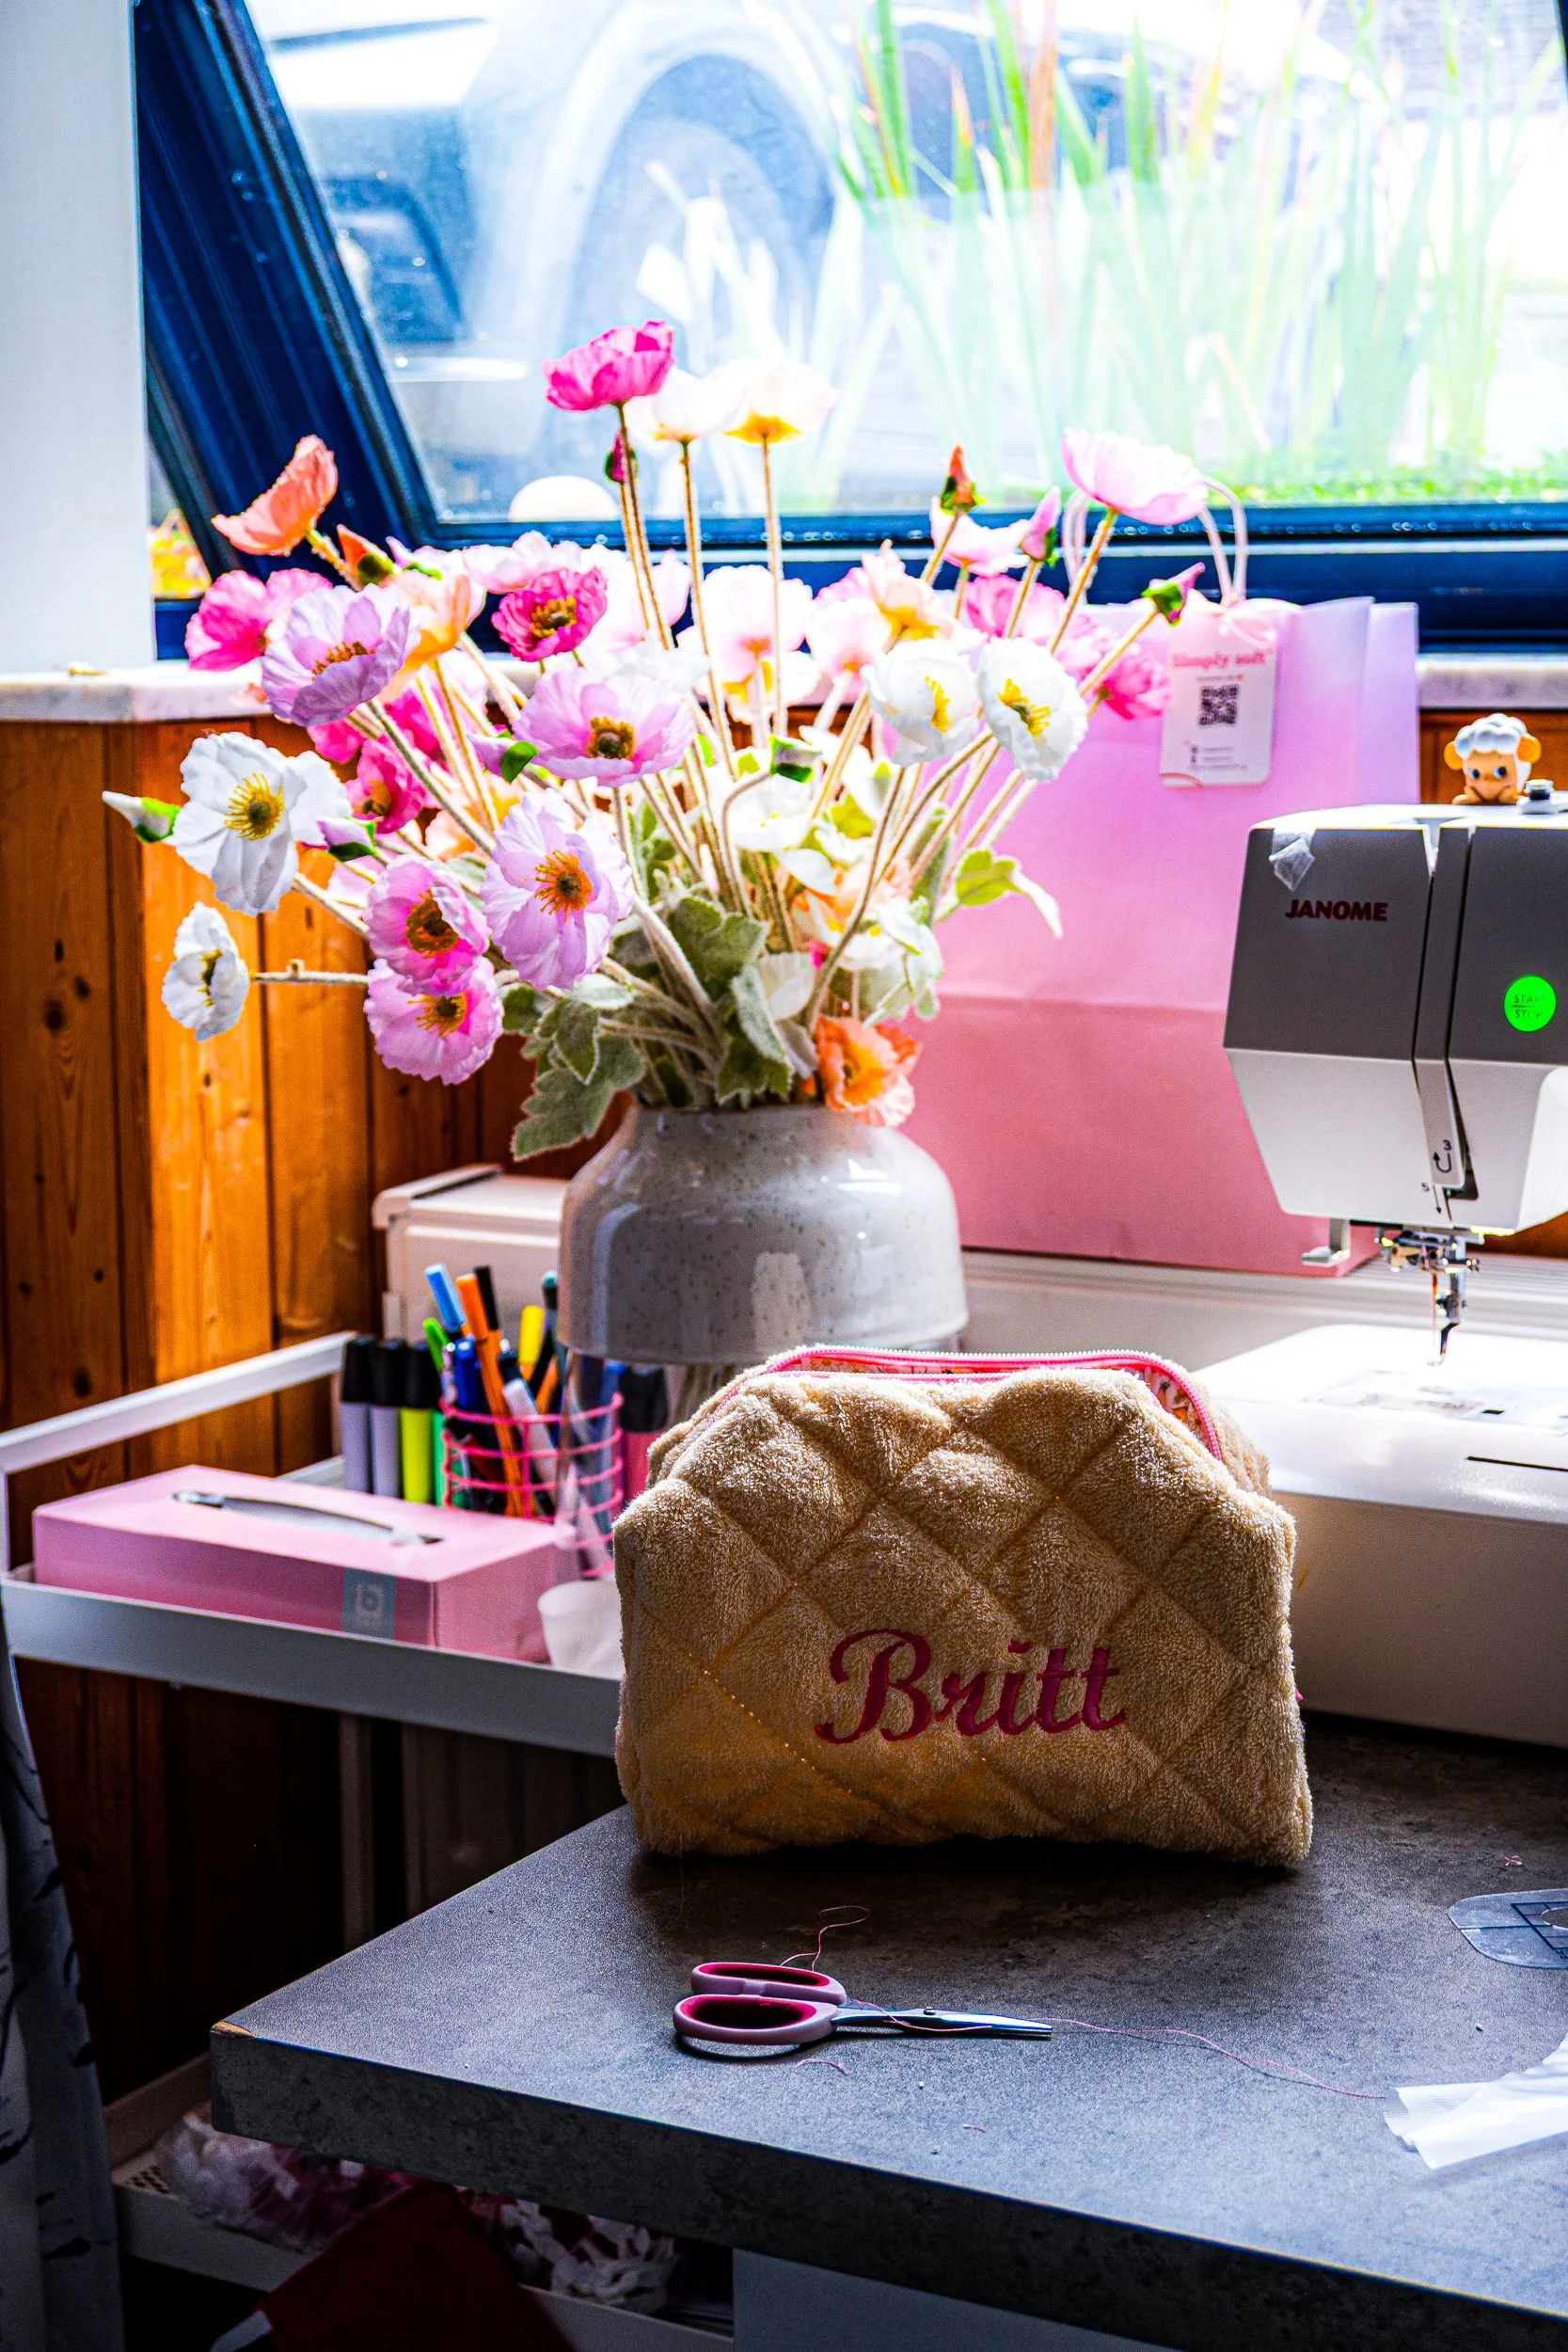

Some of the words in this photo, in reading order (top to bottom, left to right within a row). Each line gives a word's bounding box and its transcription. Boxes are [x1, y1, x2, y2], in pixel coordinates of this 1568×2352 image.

[1285, 898, 1388, 922] JANOME
[1443, 1138, 1452, 1152] 3
[815, 1628, 1126, 1745] Britt
